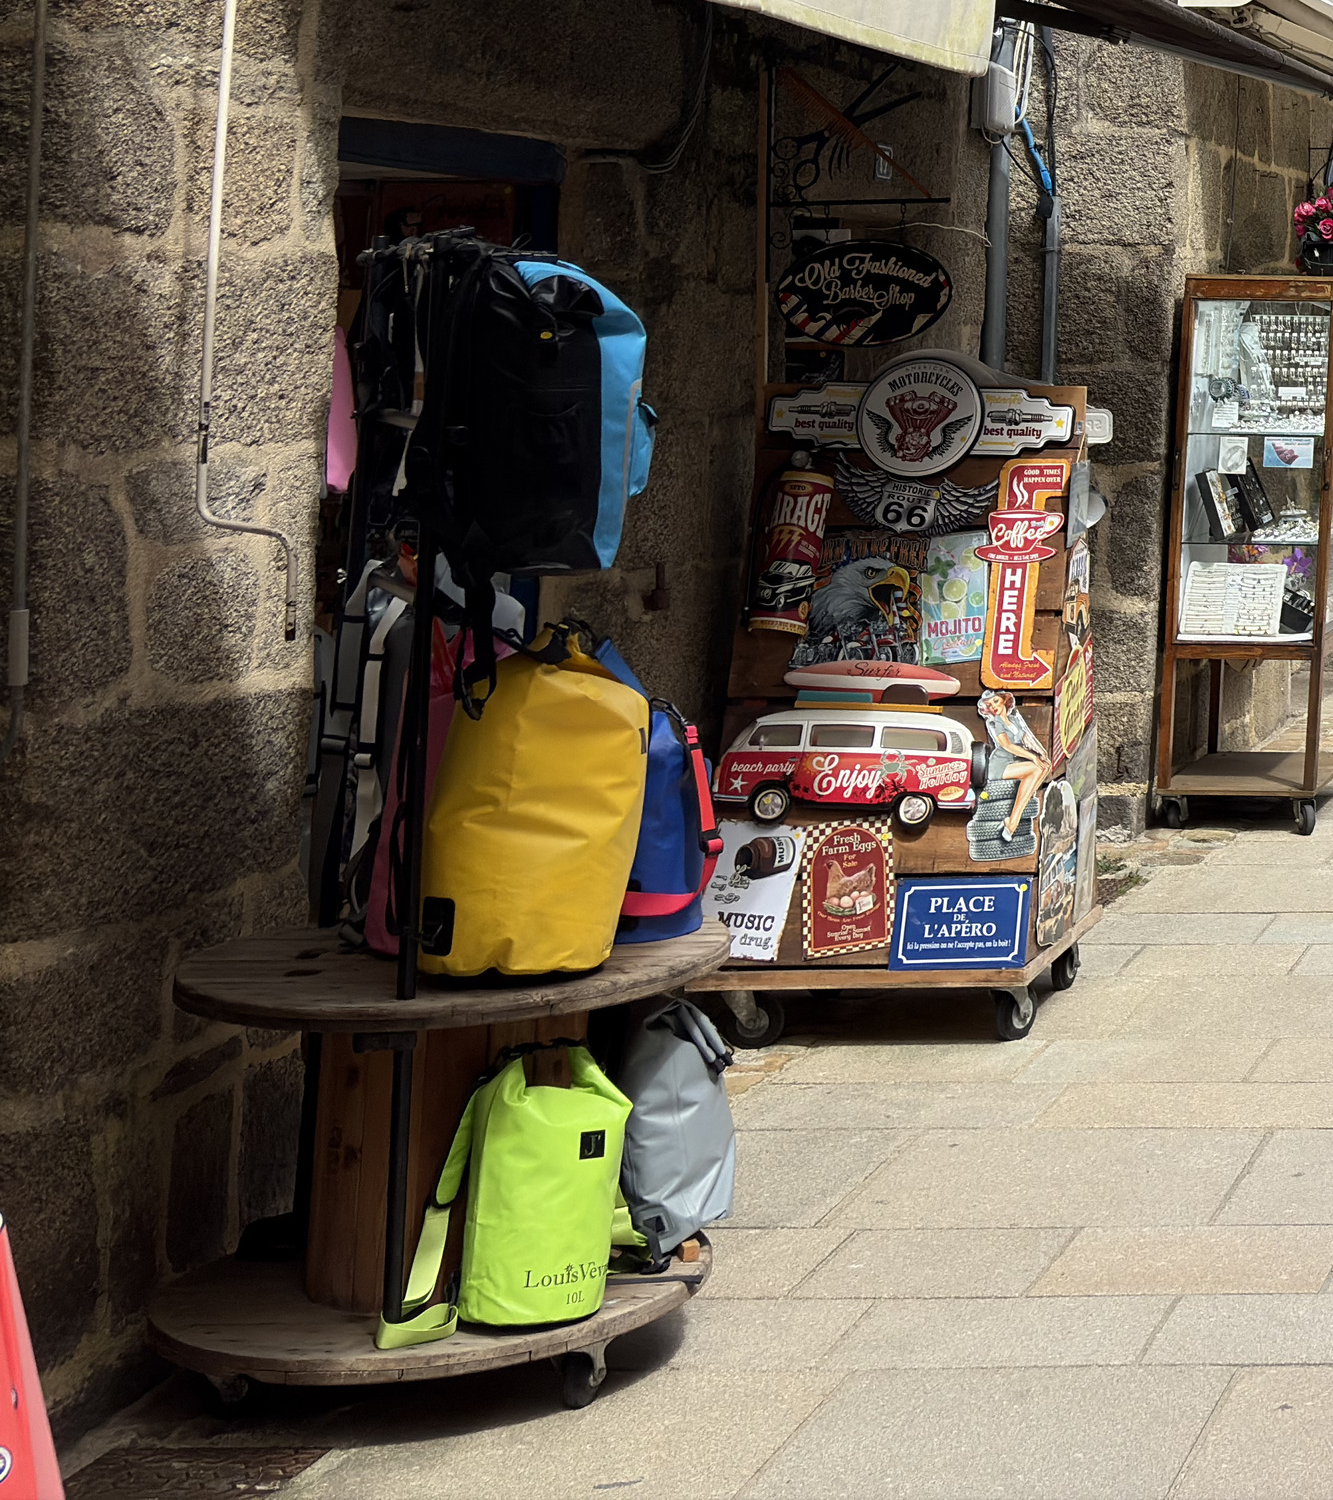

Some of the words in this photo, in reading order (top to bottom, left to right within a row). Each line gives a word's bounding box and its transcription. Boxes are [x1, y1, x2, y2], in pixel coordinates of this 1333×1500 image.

[794, 257, 841, 289] Old
[842, 253, 937, 288] Fashioned
[822, 278, 876, 304] Barber
[873, 284, 915, 310] Shop
[888, 371, 964, 397] MOTORCYCLES
[794, 418, 816, 429] best
[818, 419, 855, 431] quality
[983, 425, 1005, 437] best
[1006, 426, 1042, 439] quality
[892, 483, 933, 497] HISTORIC
[887, 493, 932, 507] ROUTE
[770, 492, 832, 539] ARAGE
[882, 502, 930, 528] 66
[992, 520, 1048, 548] Coffee
[997, 568, 1022, 655] HERE
[927, 617, 982, 638] MOJITO
[853, 661, 901, 681] Surfer
[731, 760, 763, 772] beach
[763, 760, 796, 775] party
[916, 760, 967, 775] Summer
[812, 754, 885, 798] Enjoy
[919, 770, 968, 789] Holiday
[833, 833, 861, 845] Fresh
[822, 844, 849, 856] Farm
[852, 840, 877, 853] Eggs
[842, 860, 858, 868] Sale
[843, 853, 857, 861] For
[928, 896, 995, 913] PLACE
[718, 911, 775, 932] MUSIC
[953, 913, 966, 921] DE
[923, 919, 997, 938] L'APÉRO
[740, 933, 774, 949] drug.
[906, 942, 914, 950] Ici
[566, 1290, 585, 1305] 10L
